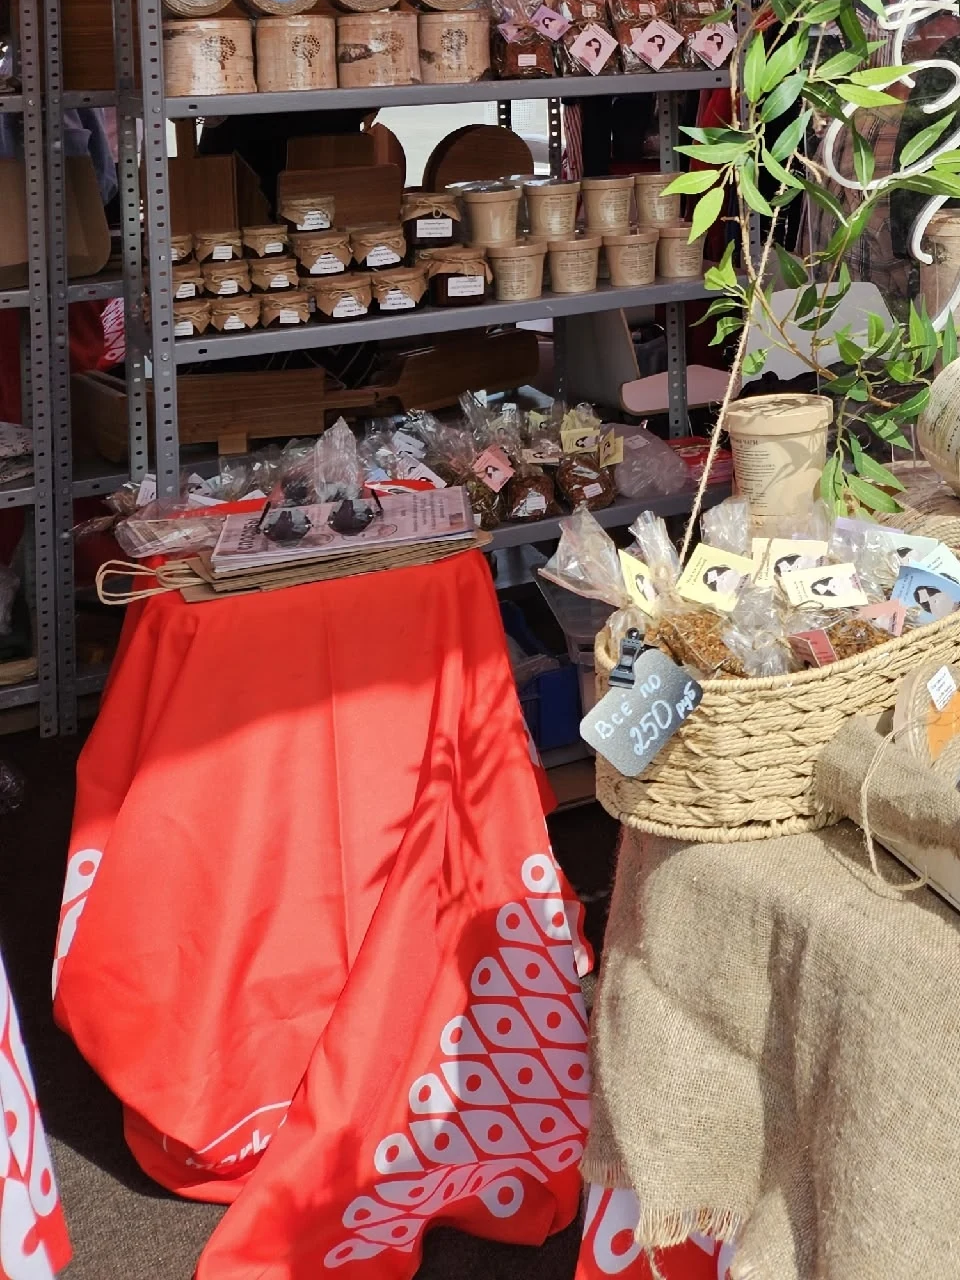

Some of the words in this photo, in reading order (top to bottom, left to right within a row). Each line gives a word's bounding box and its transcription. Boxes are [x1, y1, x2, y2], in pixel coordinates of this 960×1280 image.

[640, 674, 661, 698] по
[629, 699, 673, 756] 250
[675, 680, 696, 720] руб
